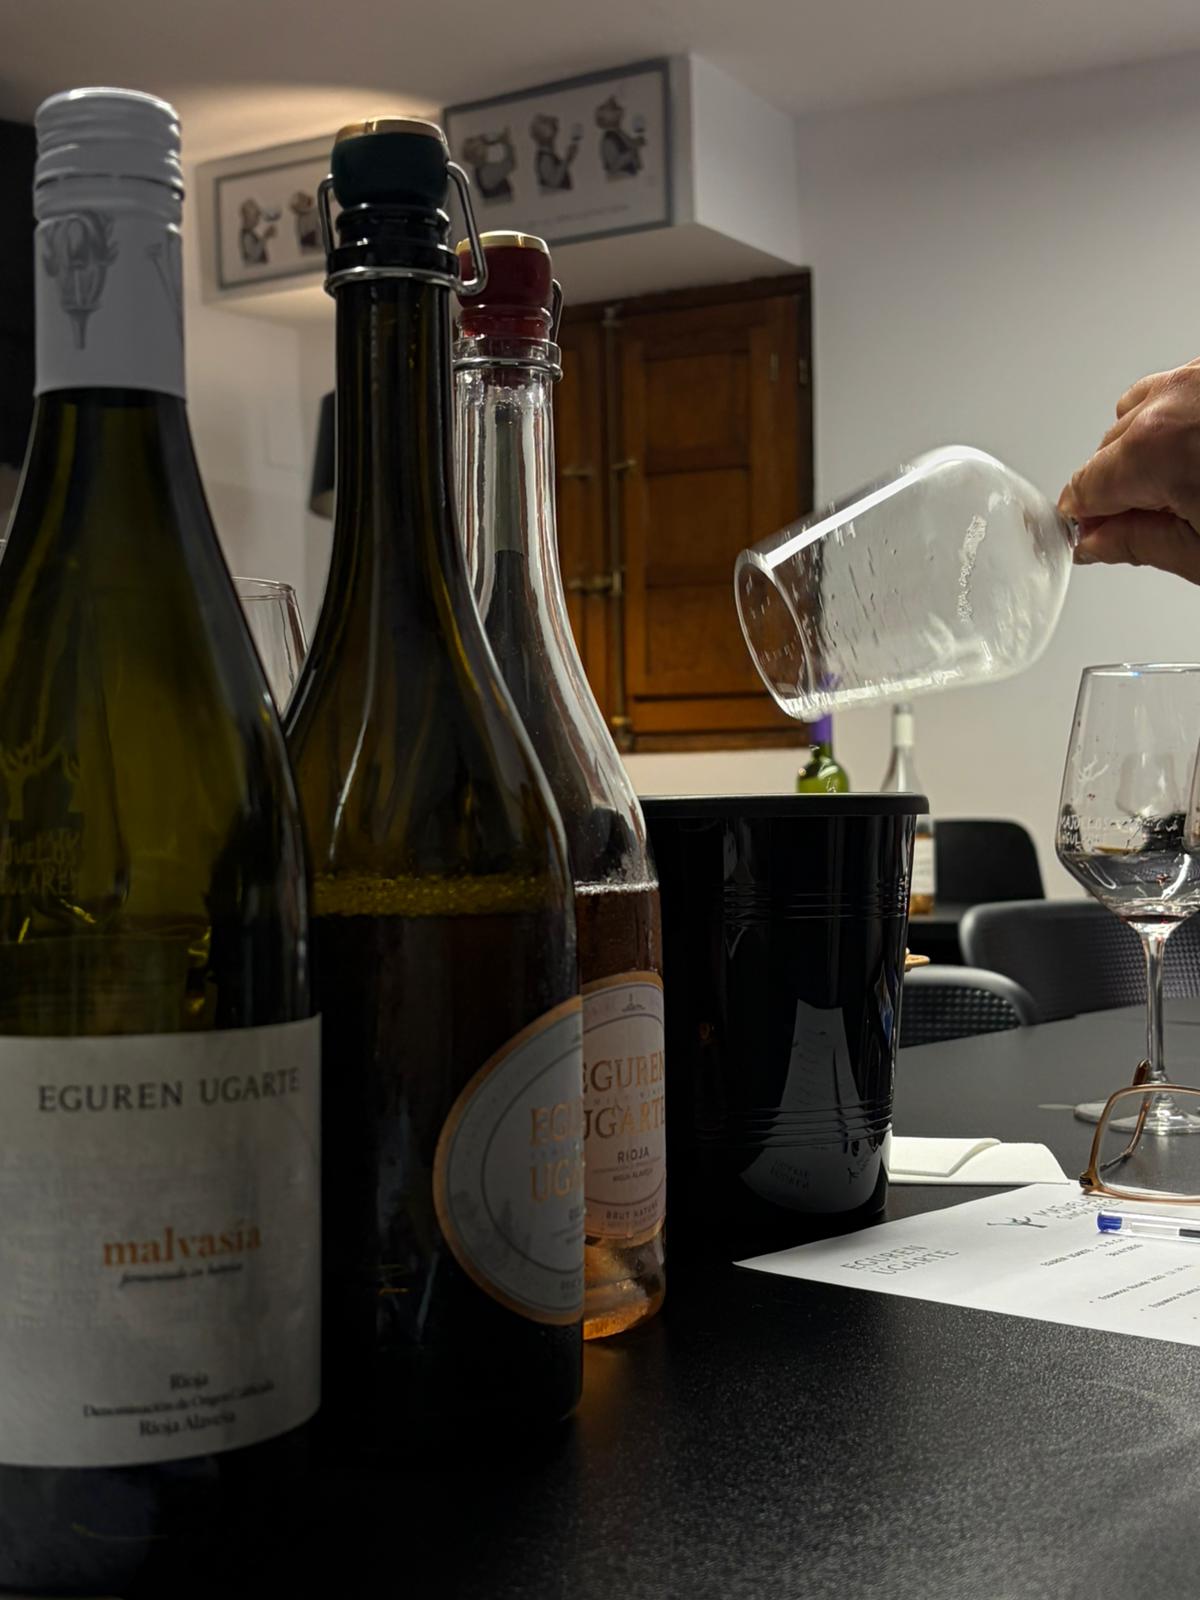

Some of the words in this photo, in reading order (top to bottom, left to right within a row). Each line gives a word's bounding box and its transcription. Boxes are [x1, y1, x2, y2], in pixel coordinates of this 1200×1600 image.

[38, 1080, 184, 1113] EGUREN
[198, 1066, 300, 1106] UGARTE
[617, 1147, 650, 1164] RIOJA
[840, 1245, 928, 1270] EGUREN
[872, 1250, 959, 1275] UGARTE
